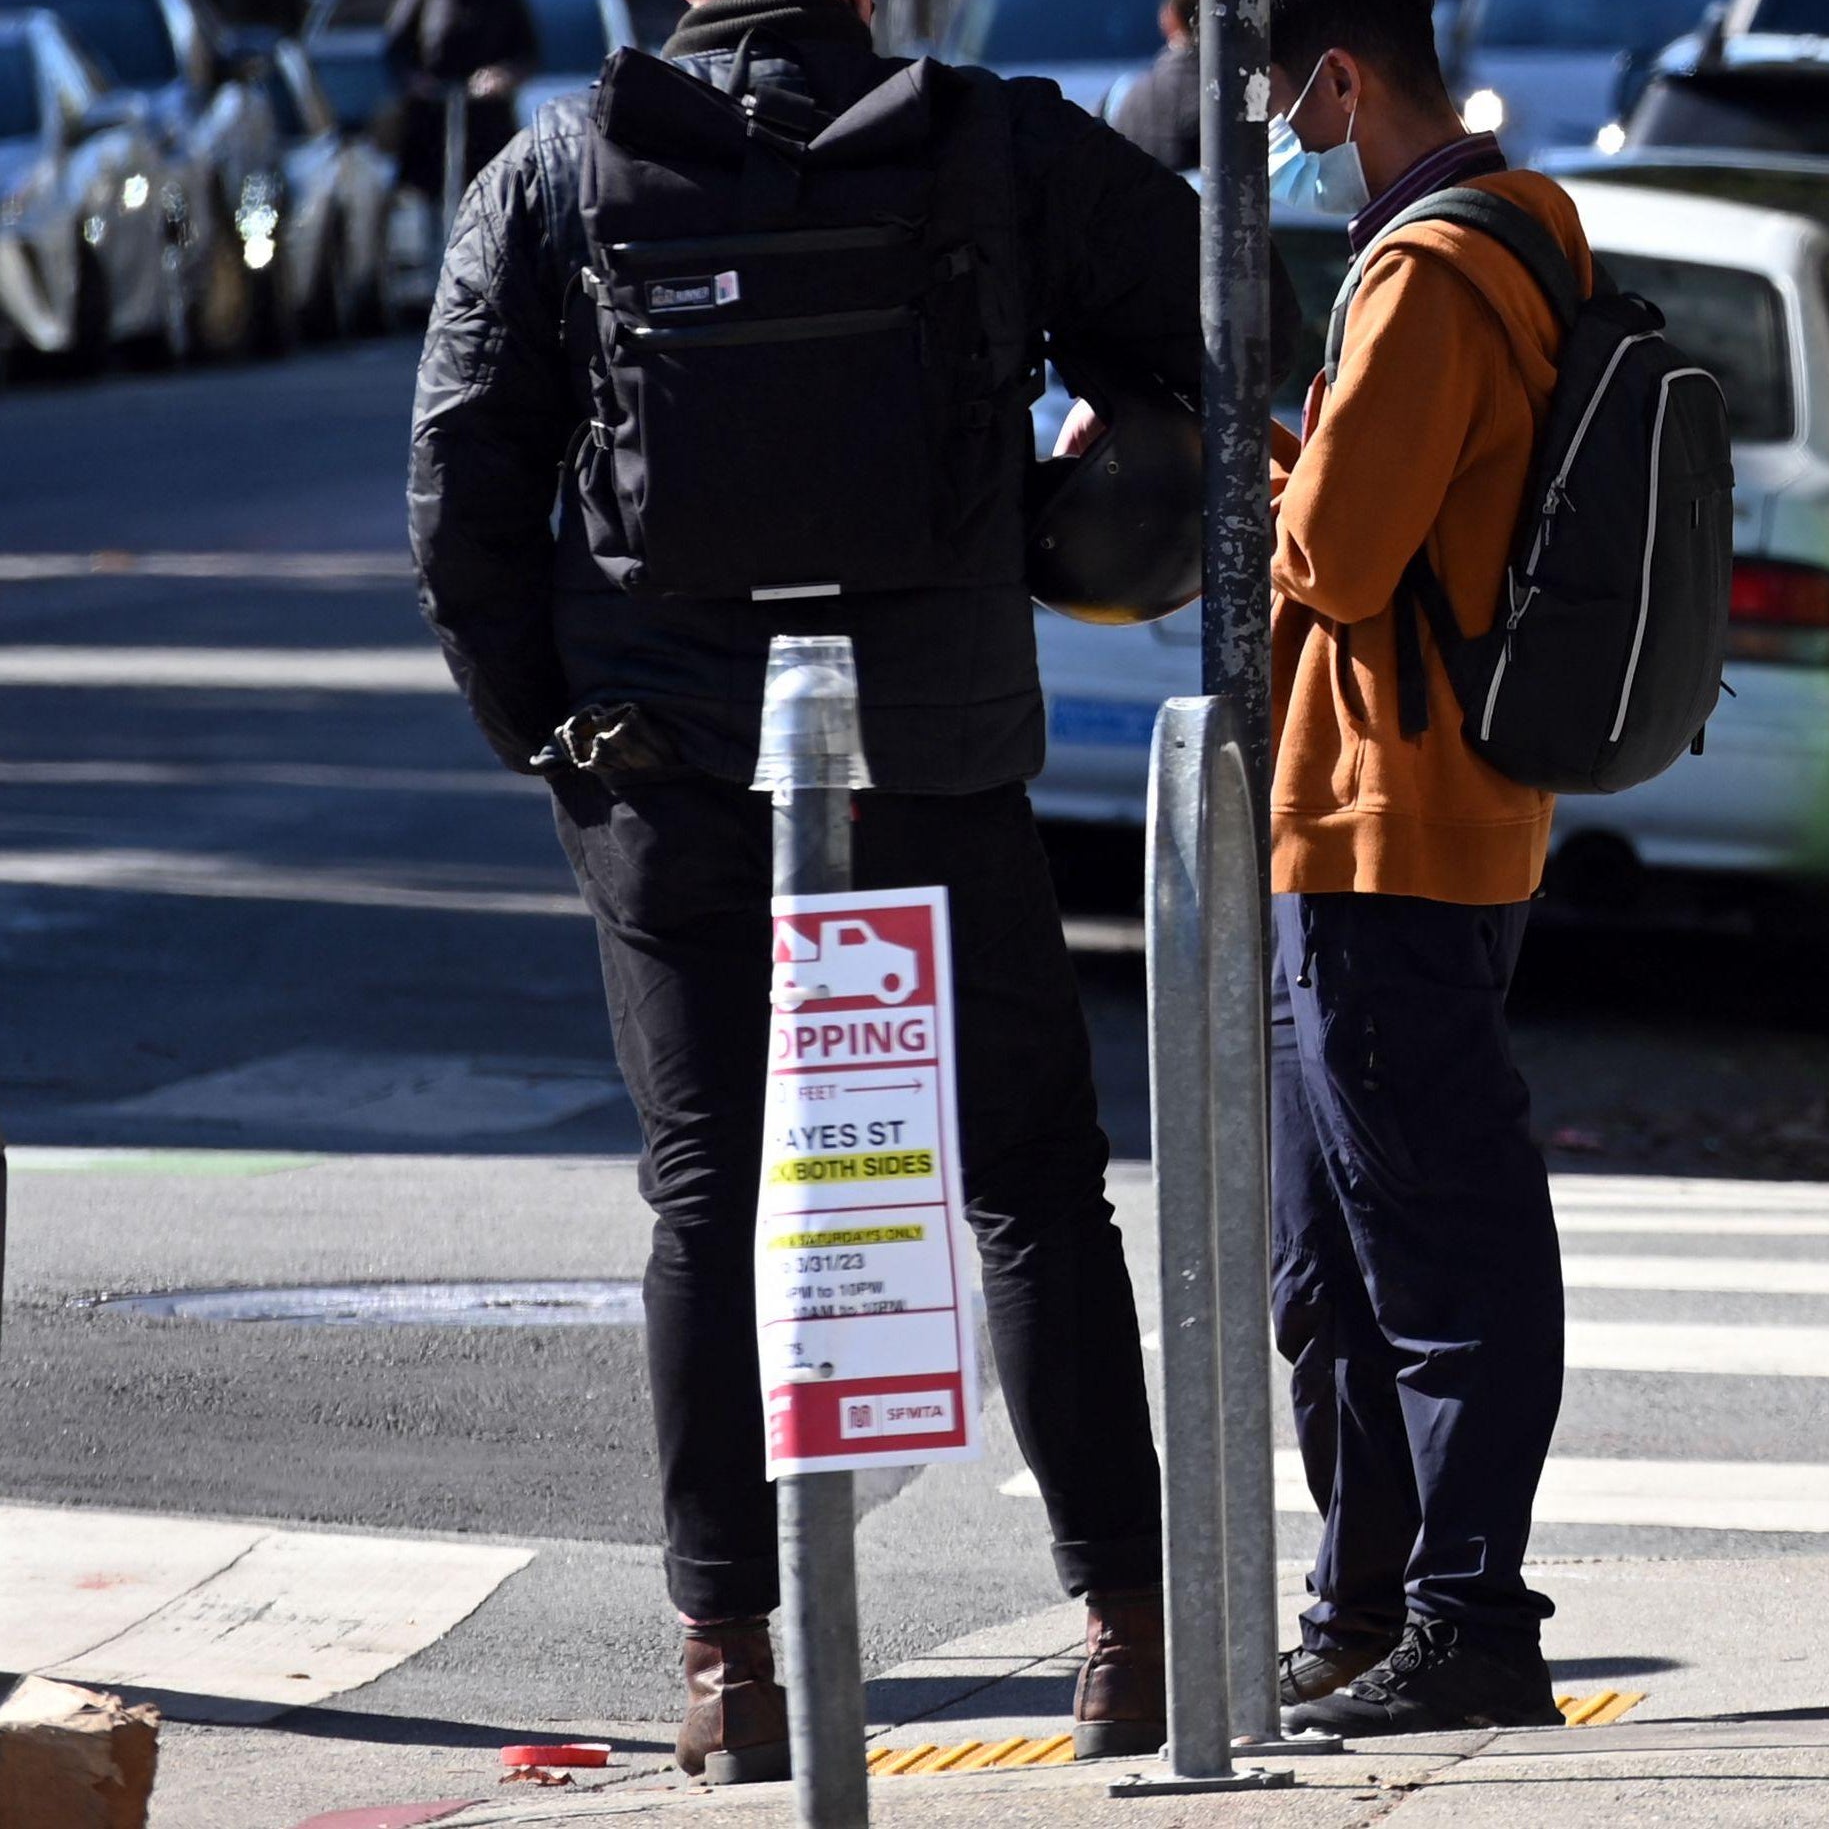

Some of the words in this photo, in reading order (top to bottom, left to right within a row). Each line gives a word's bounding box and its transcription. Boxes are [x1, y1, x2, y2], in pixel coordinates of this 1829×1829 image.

[777, 1123, 858, 1150] AYES
[868, 1120, 905, 1145] ST
[863, 1153, 932, 1176] SIDES
[886, 1405, 943, 1421] SFMTA
